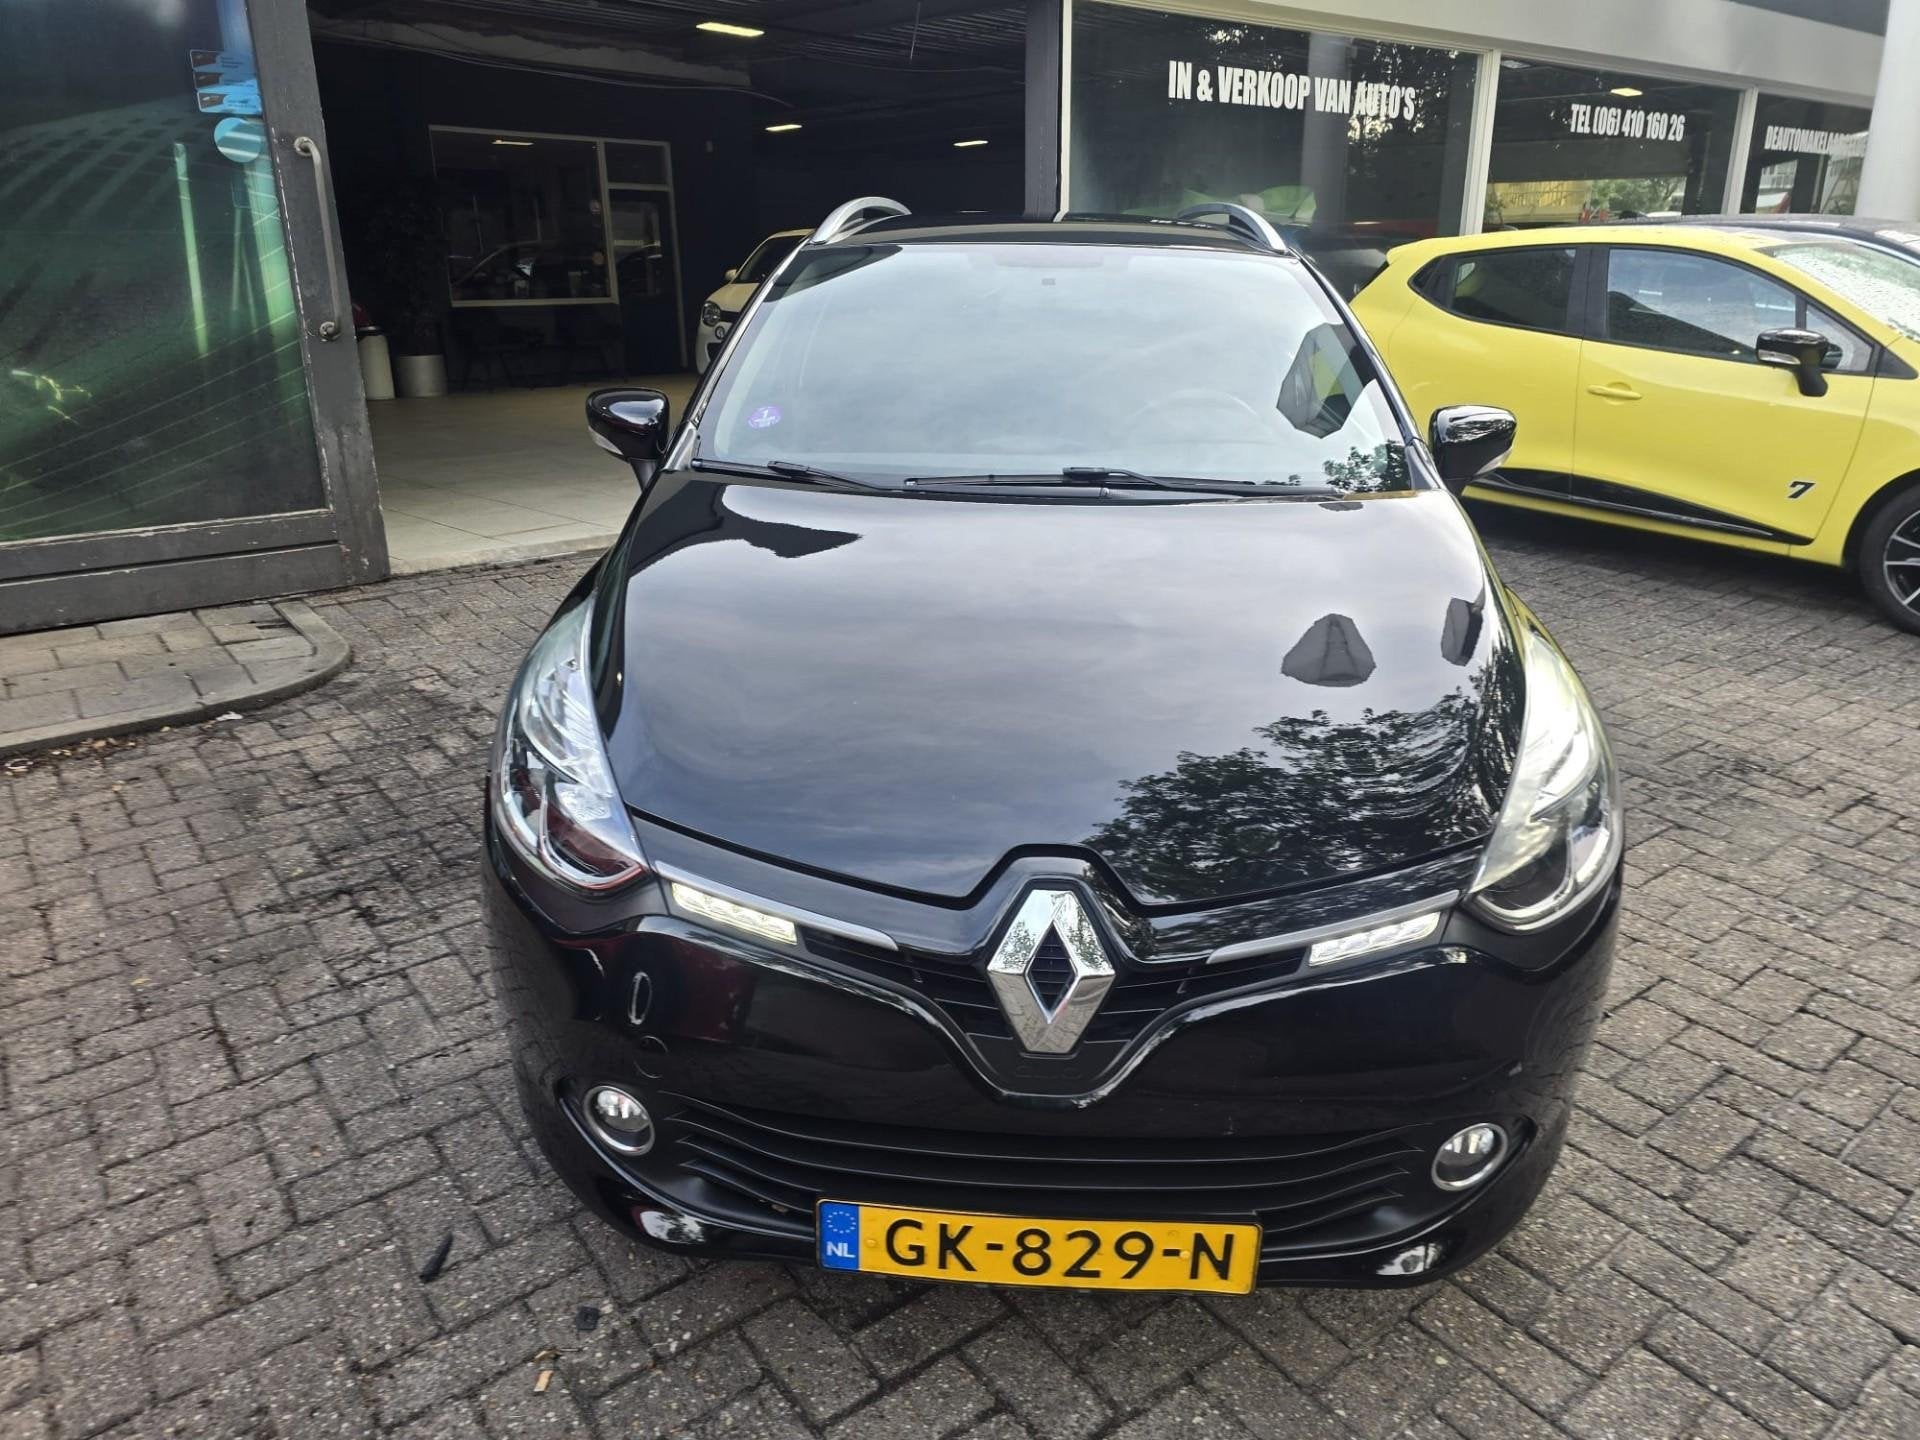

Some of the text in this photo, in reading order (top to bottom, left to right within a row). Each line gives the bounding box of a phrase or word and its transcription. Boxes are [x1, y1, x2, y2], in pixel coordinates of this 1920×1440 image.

[1168, 60, 1416, 121] IN & VERKOOP VAN AUTO'S
[1570, 103, 1686, 142] TEL (06) 410 160 26
[1787, 480, 1816, 499] 7
[826, 1241, 856, 1258] NL
[885, 1218, 1235, 1280] GK-829-N
